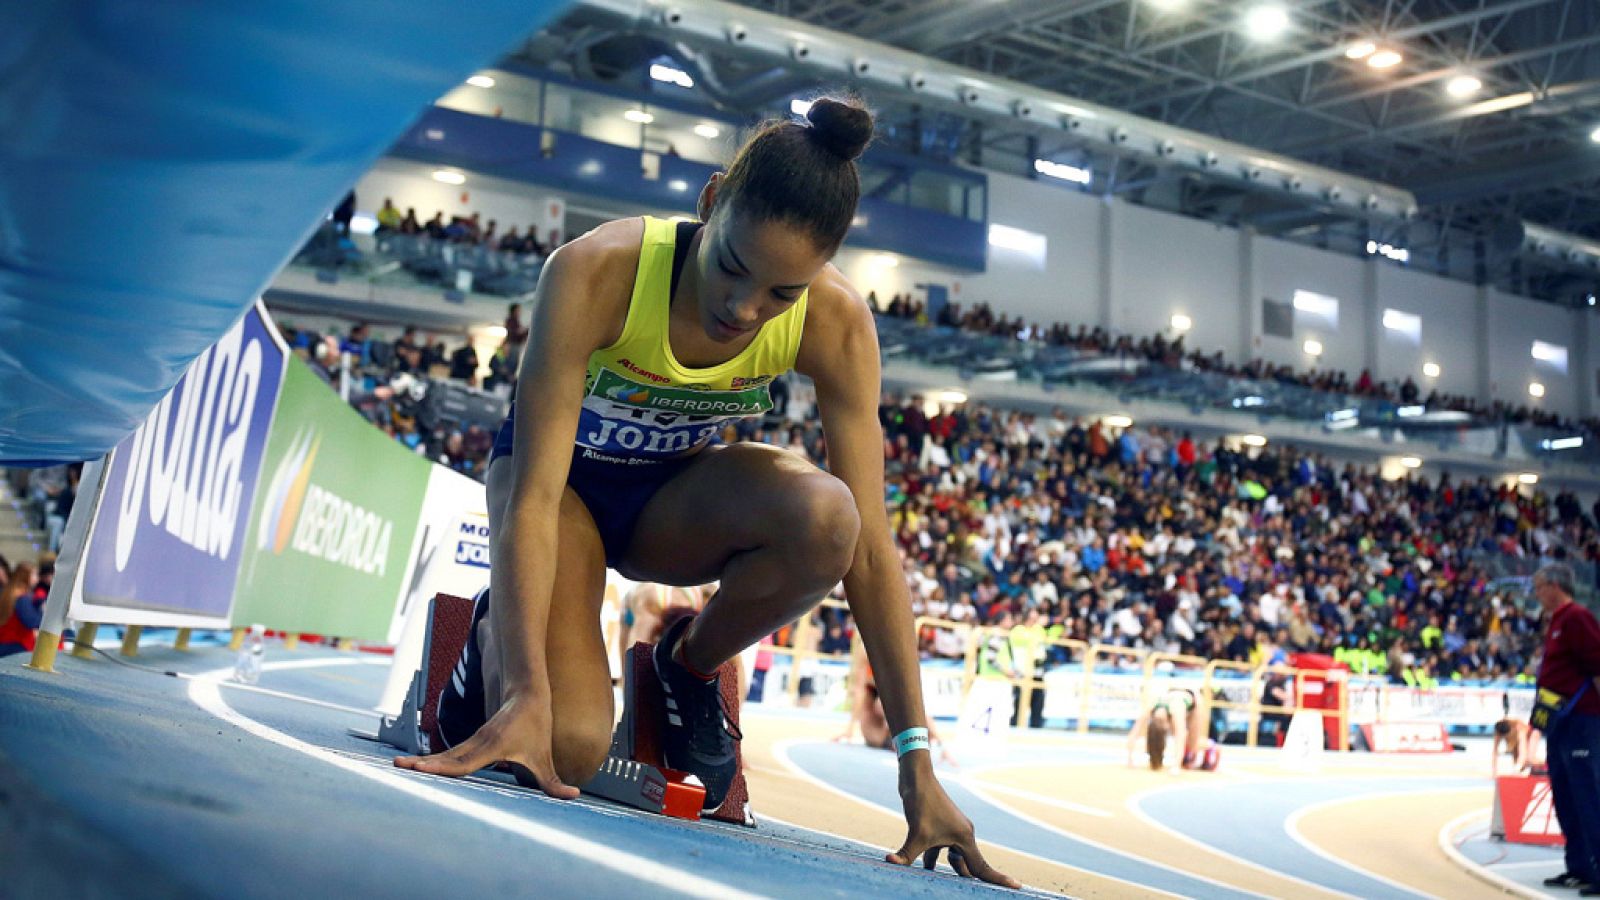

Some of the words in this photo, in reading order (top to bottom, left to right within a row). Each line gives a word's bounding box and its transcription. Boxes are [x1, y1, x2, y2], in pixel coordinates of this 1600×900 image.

[616, 358, 671, 384] Alcampo
[651, 396, 761, 413] IBERDROLA
[291, 482, 394, 578] IBERDROLA
